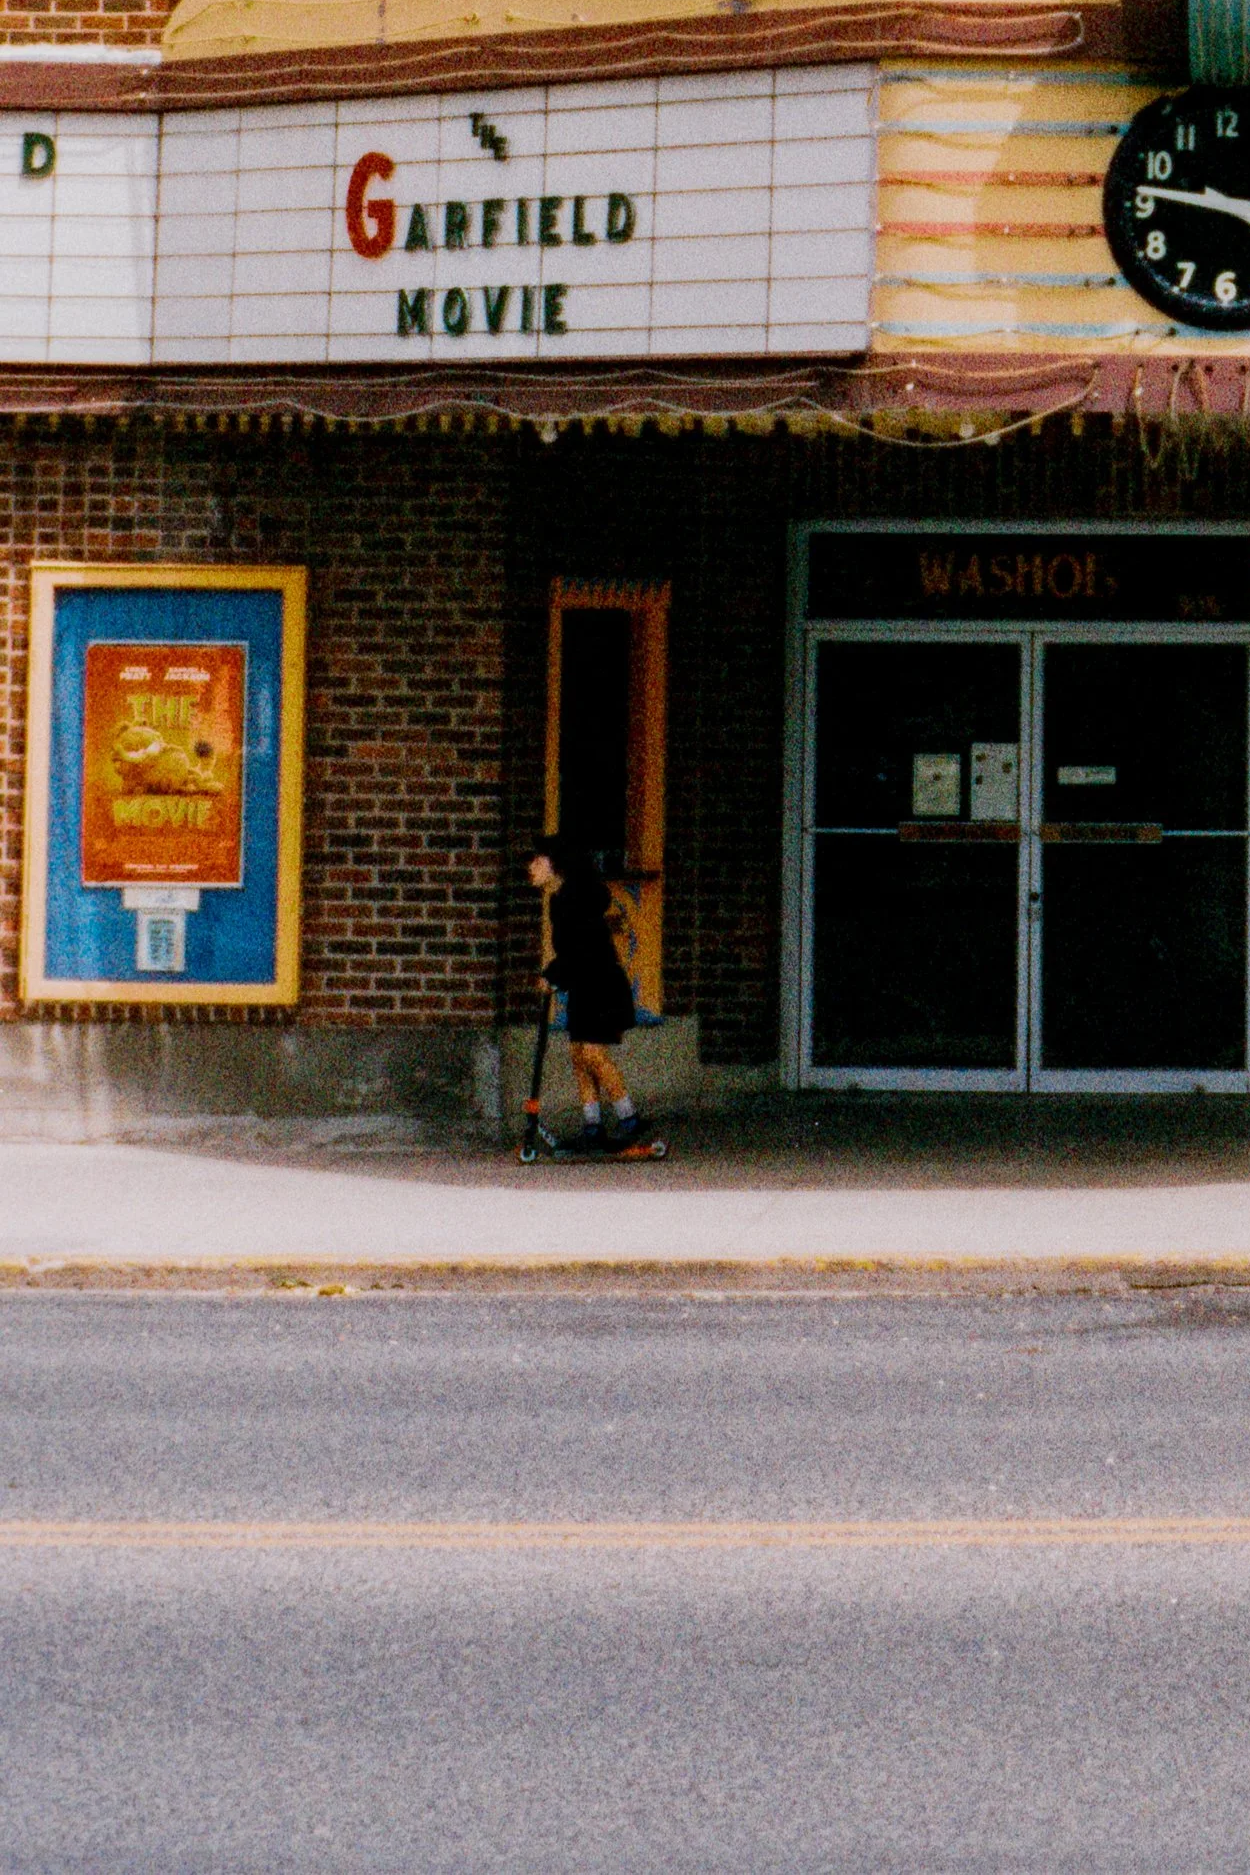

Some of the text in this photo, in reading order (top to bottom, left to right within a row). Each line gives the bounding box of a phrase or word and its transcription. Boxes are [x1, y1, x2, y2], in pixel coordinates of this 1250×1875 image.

[469, 112, 508, 162] THE
[1177, 124, 1196, 151] 11
[1216, 112, 1239, 137] 12
[22, 132, 56, 179] D
[1147, 151, 1172, 180] 10
[346, 152, 637, 259] GARFIELD
[1135, 191, 1155, 218] 9
[1147, 230, 1166, 260] 8
[1177, 262, 1196, 288] 7
[1215, 271, 1237, 302] 6
[397, 283, 569, 336] MOVIE
[113, 797, 213, 829] MOVIE
